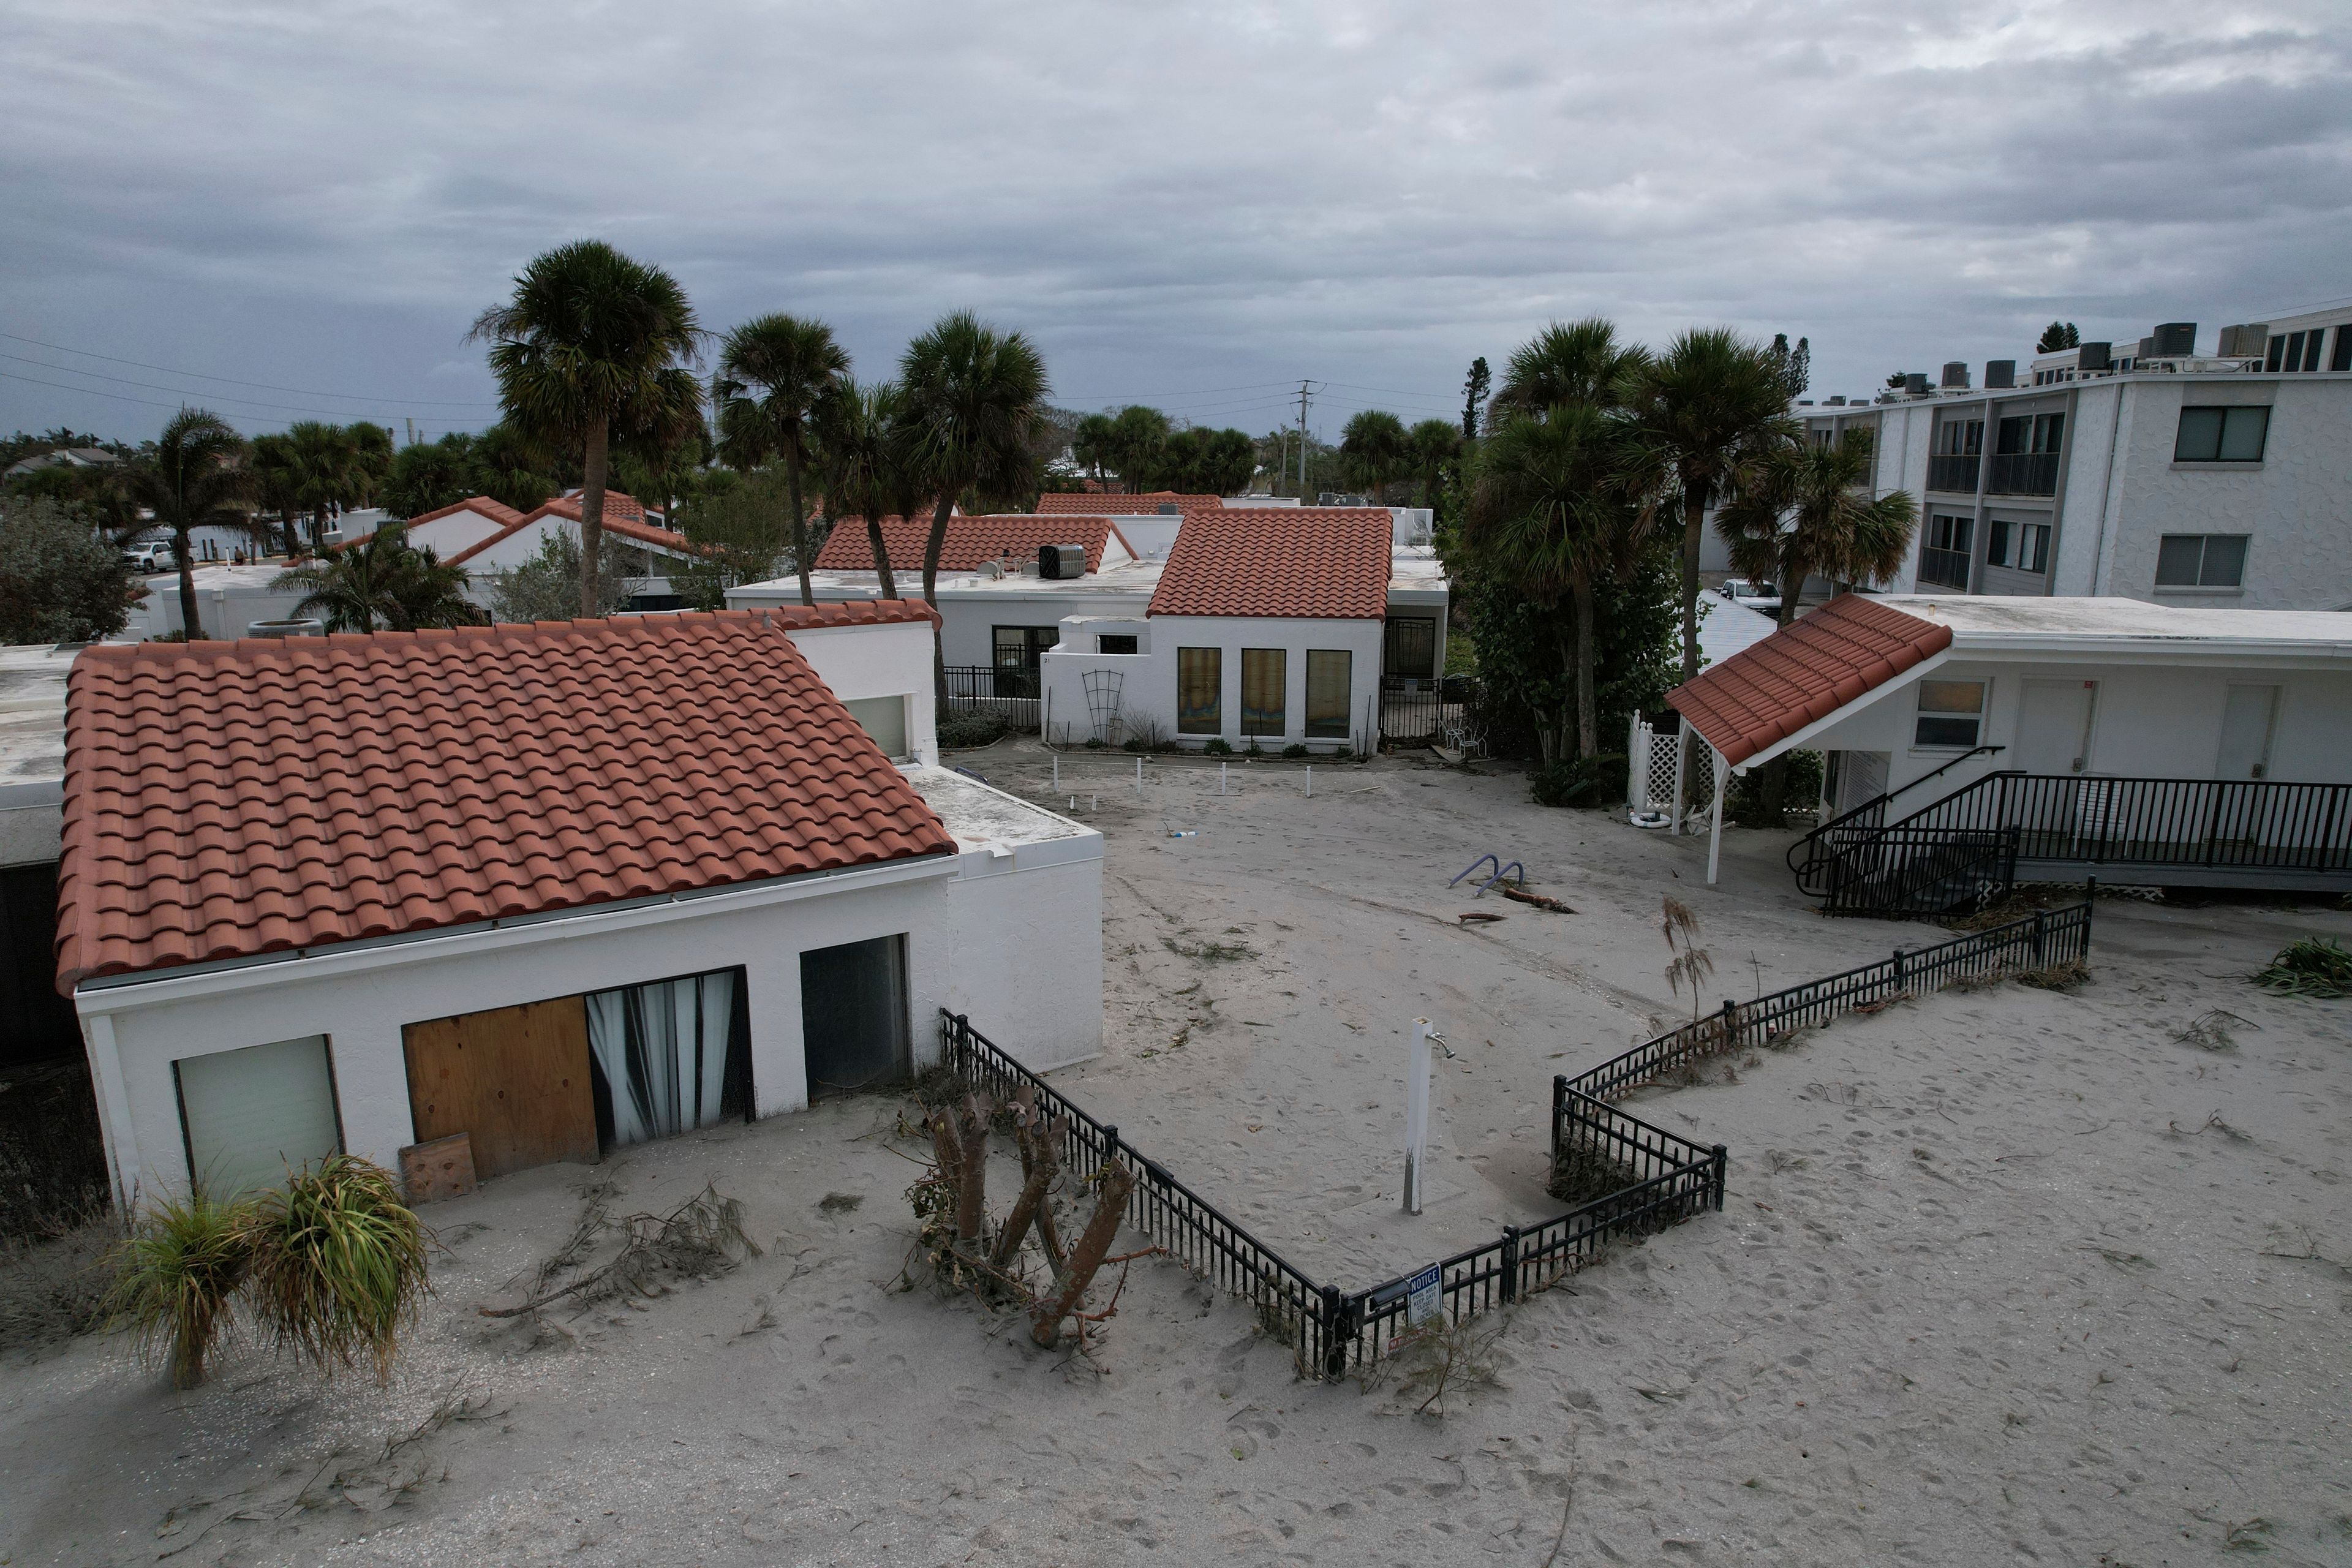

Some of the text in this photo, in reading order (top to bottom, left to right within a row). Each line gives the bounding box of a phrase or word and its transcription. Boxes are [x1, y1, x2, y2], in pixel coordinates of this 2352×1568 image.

[1411, 1269, 1438, 1292] NOTICE
[1413, 1284, 1436, 1301] POOL AREA
[1414, 1292, 1436, 1307] KEEP GATE
[1417, 1298, 1434, 1311] CLOSED
[1417, 1309, 1434, 1322] LOCKED
